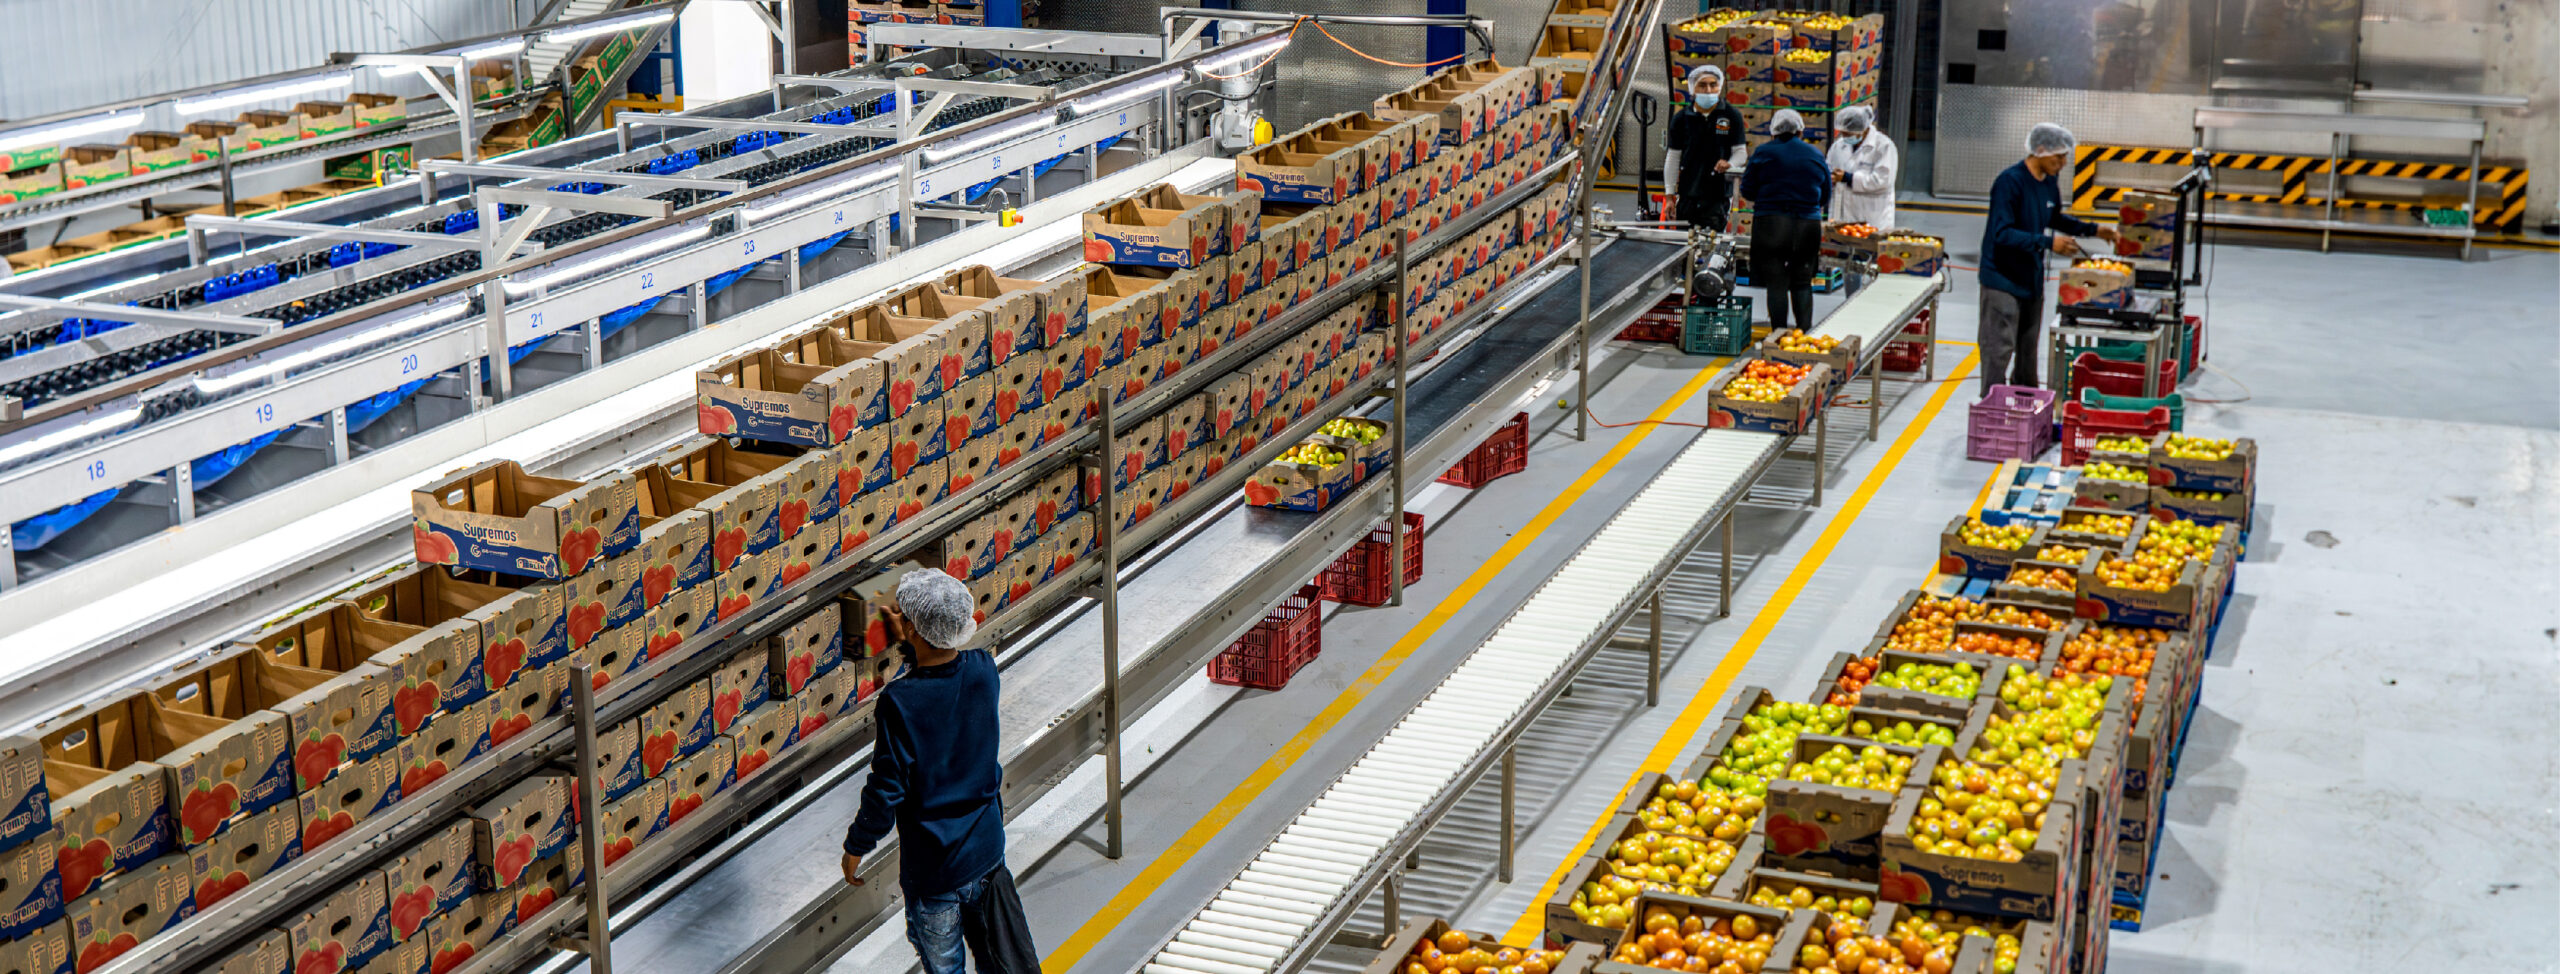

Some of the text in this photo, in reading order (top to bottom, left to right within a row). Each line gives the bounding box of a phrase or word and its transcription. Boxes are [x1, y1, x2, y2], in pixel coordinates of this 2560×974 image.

[1119, 112, 1127, 126] 28
[993, 156, 1001, 169] 26
[920, 179, 931, 195] 25
[1269, 172, 1305, 183] Supremos
[834, 211, 844, 224] 24
[744, 240, 755, 255] 23
[1120, 232, 1160, 244] Supremos
[642, 273, 654, 289] 22
[531, 312, 544, 329] 21
[401, 354, 418, 374] 20
[256, 404, 272, 423] 19
[742, 397, 790, 413] Supremos
[88, 460, 105, 480] 18
[464, 522, 517, 542] Supremos
[441, 678, 472, 701] Supremos
[350, 729, 383, 753] Supremos
[242, 776, 278, 803] Supremos
[0, 812, 31, 838] remos
[115, 832, 156, 860] Supremos
[1941, 865, 2005, 884] Supremos
[438, 877, 467, 901] Supremos
[1, 897, 45, 929] Supremos
[348, 931, 379, 957] Supremos
